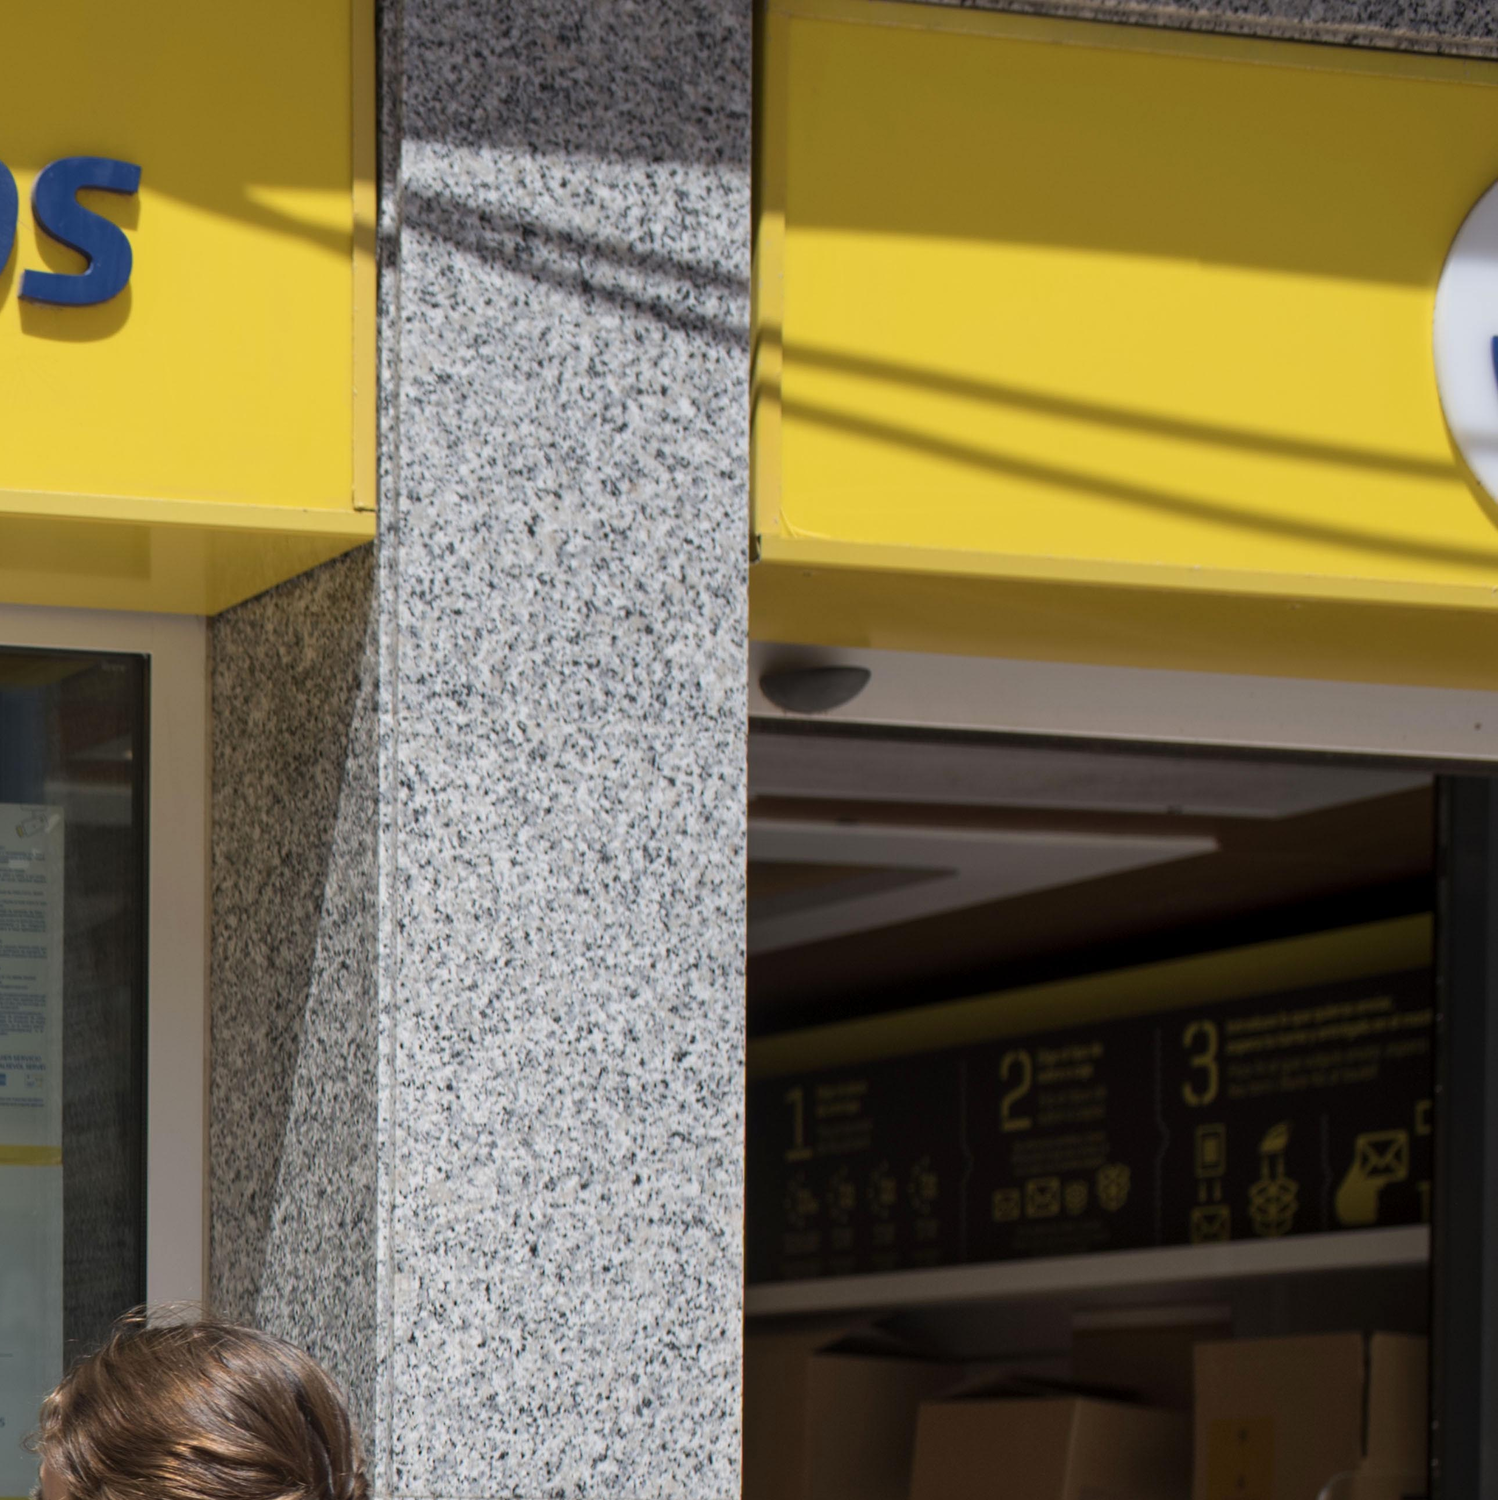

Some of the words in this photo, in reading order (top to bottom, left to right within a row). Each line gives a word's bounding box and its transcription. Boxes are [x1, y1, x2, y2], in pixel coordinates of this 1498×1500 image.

[999, 1048, 1033, 1133] 2
[1182, 1018, 1218, 1107] 3
[784, 1086, 814, 1164] 1
